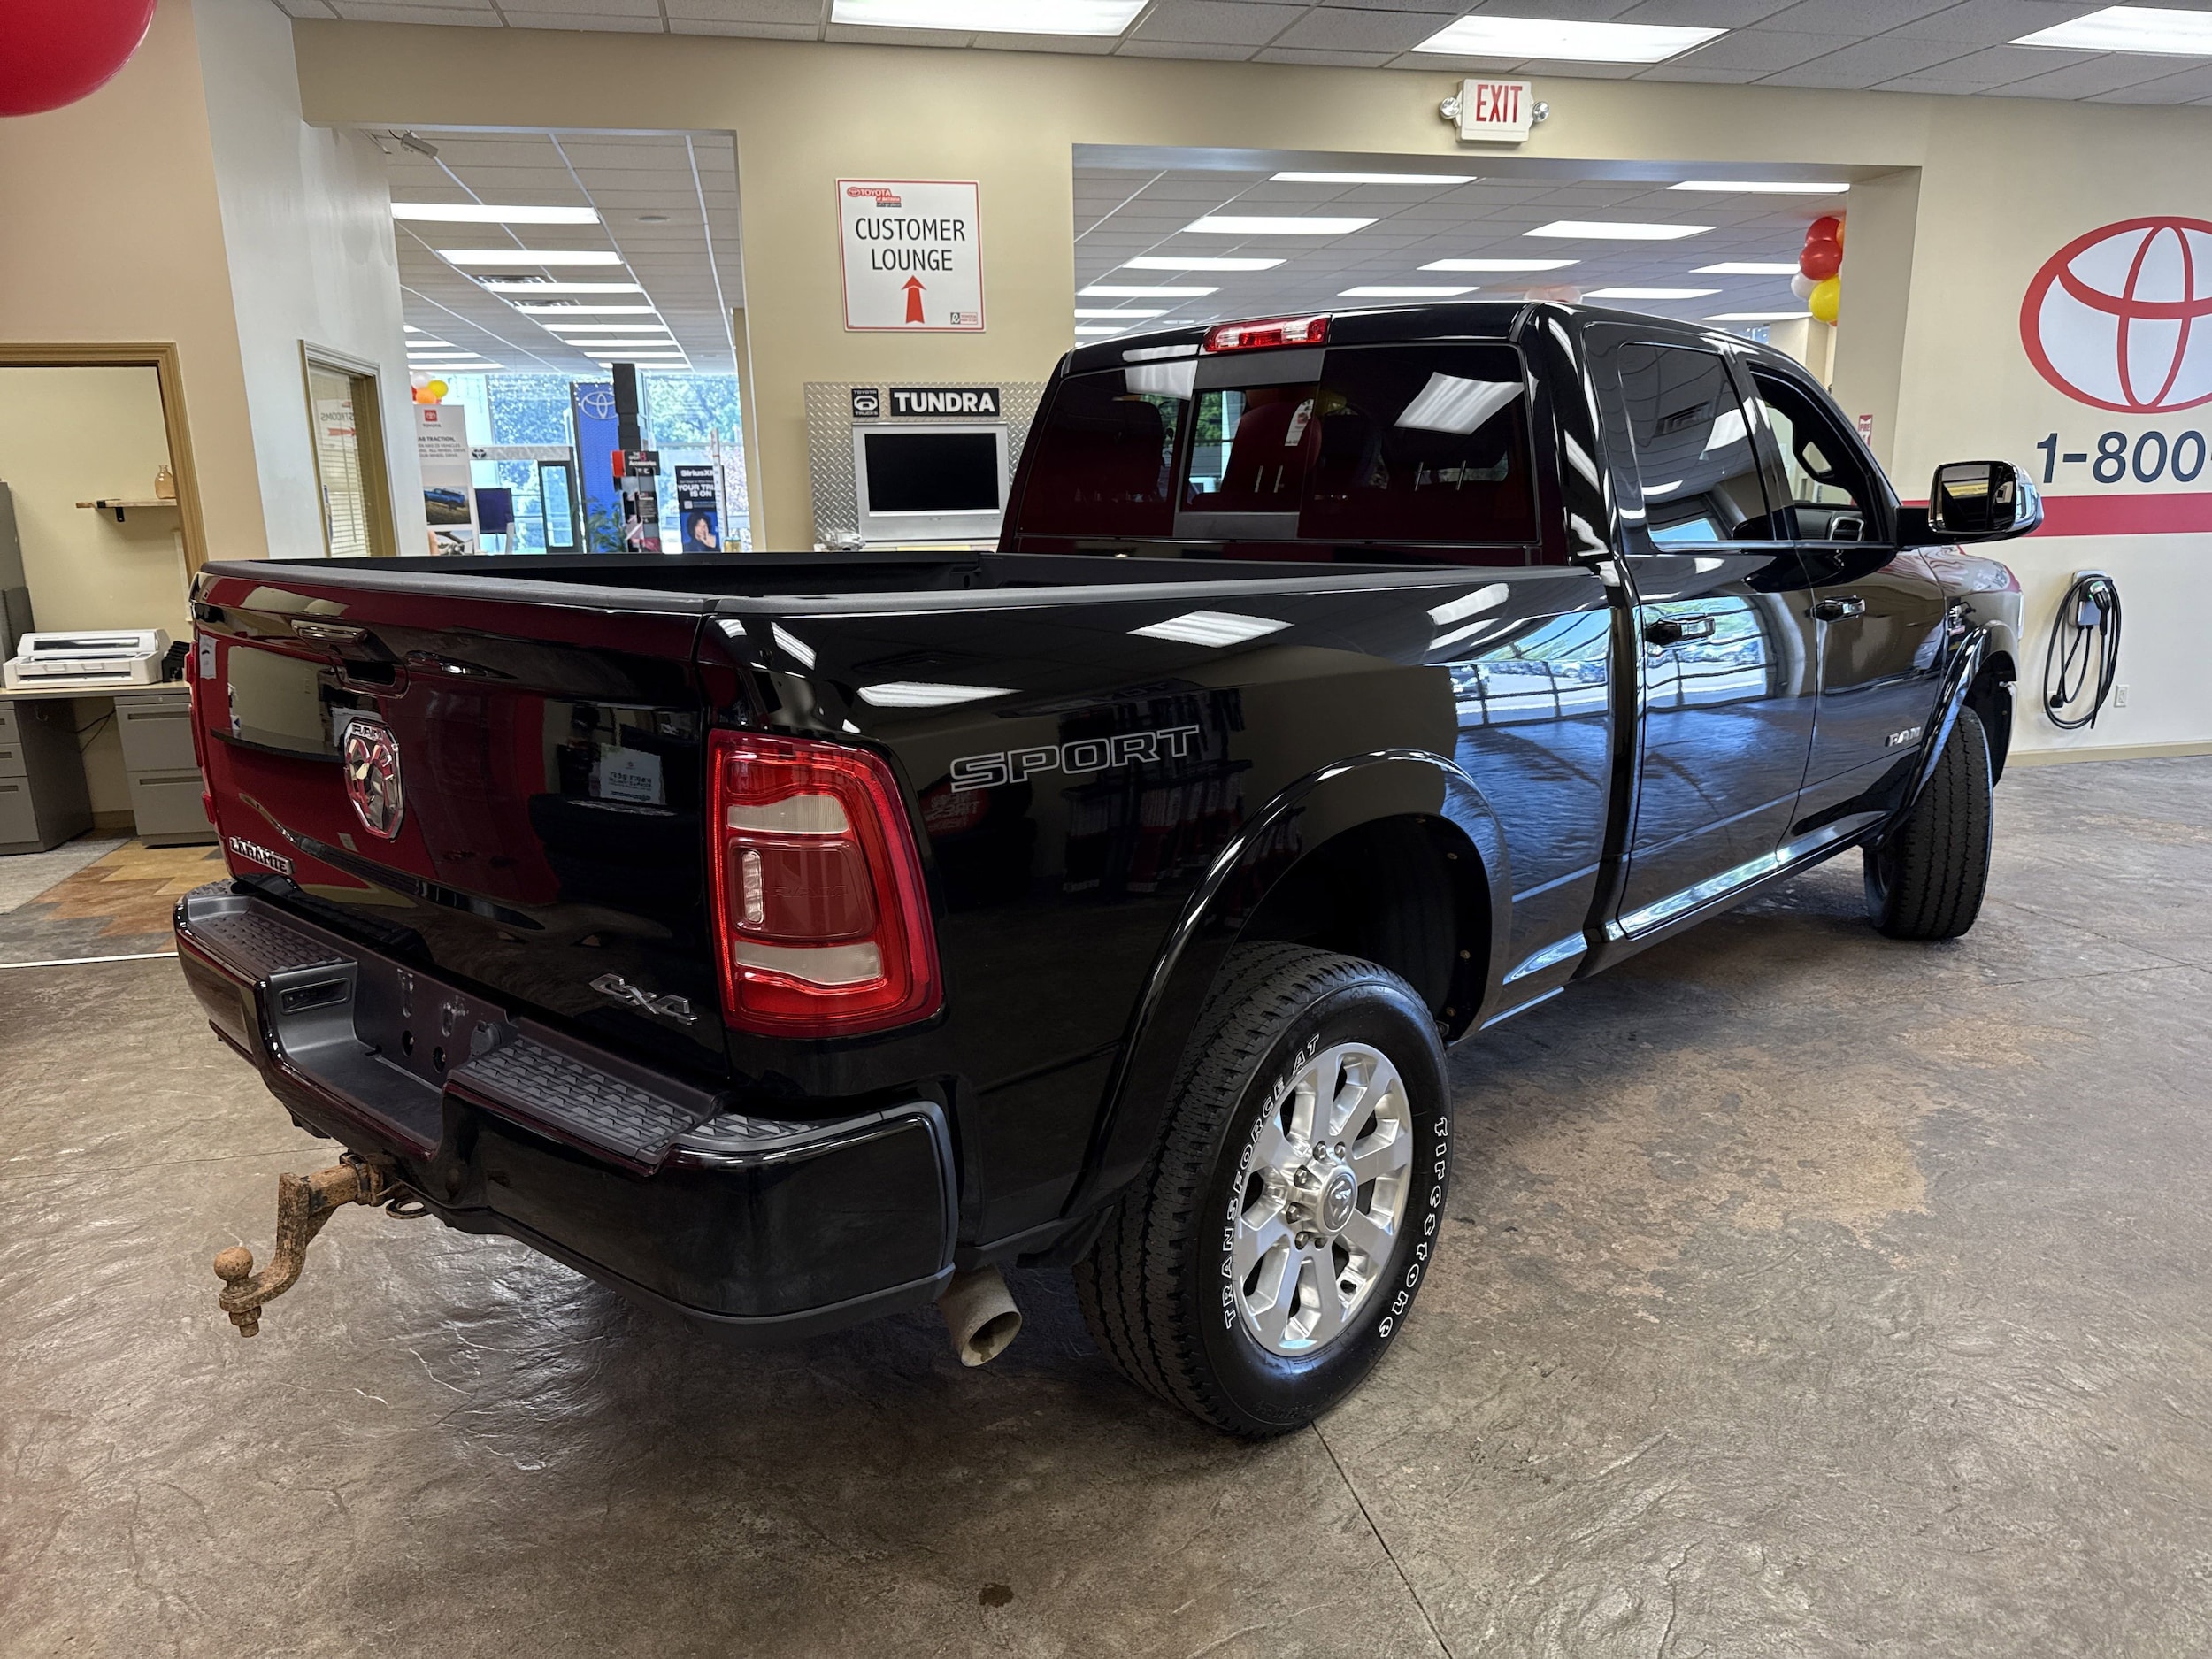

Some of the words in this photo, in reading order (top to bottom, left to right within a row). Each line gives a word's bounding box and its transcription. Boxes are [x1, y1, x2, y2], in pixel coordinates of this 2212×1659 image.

[1476, 84, 1523, 123] EXIT
[860, 188, 891, 196] TOYOTA
[856, 217, 966, 242] CUSTOMER
[871, 248, 954, 272] LOUNGE
[894, 392, 996, 413] TUNDRA
[2036, 430, 2212, 484] 1-800
[352, 724, 383, 741] RAM
[1885, 726, 1921, 747] RAM
[950, 724, 1200, 793] SPORT
[229, 836, 293, 876] LARAMIE
[1222, 1075, 1285, 1329] TRANSFORCE
[1293, 1033, 1320, 1075] AT
